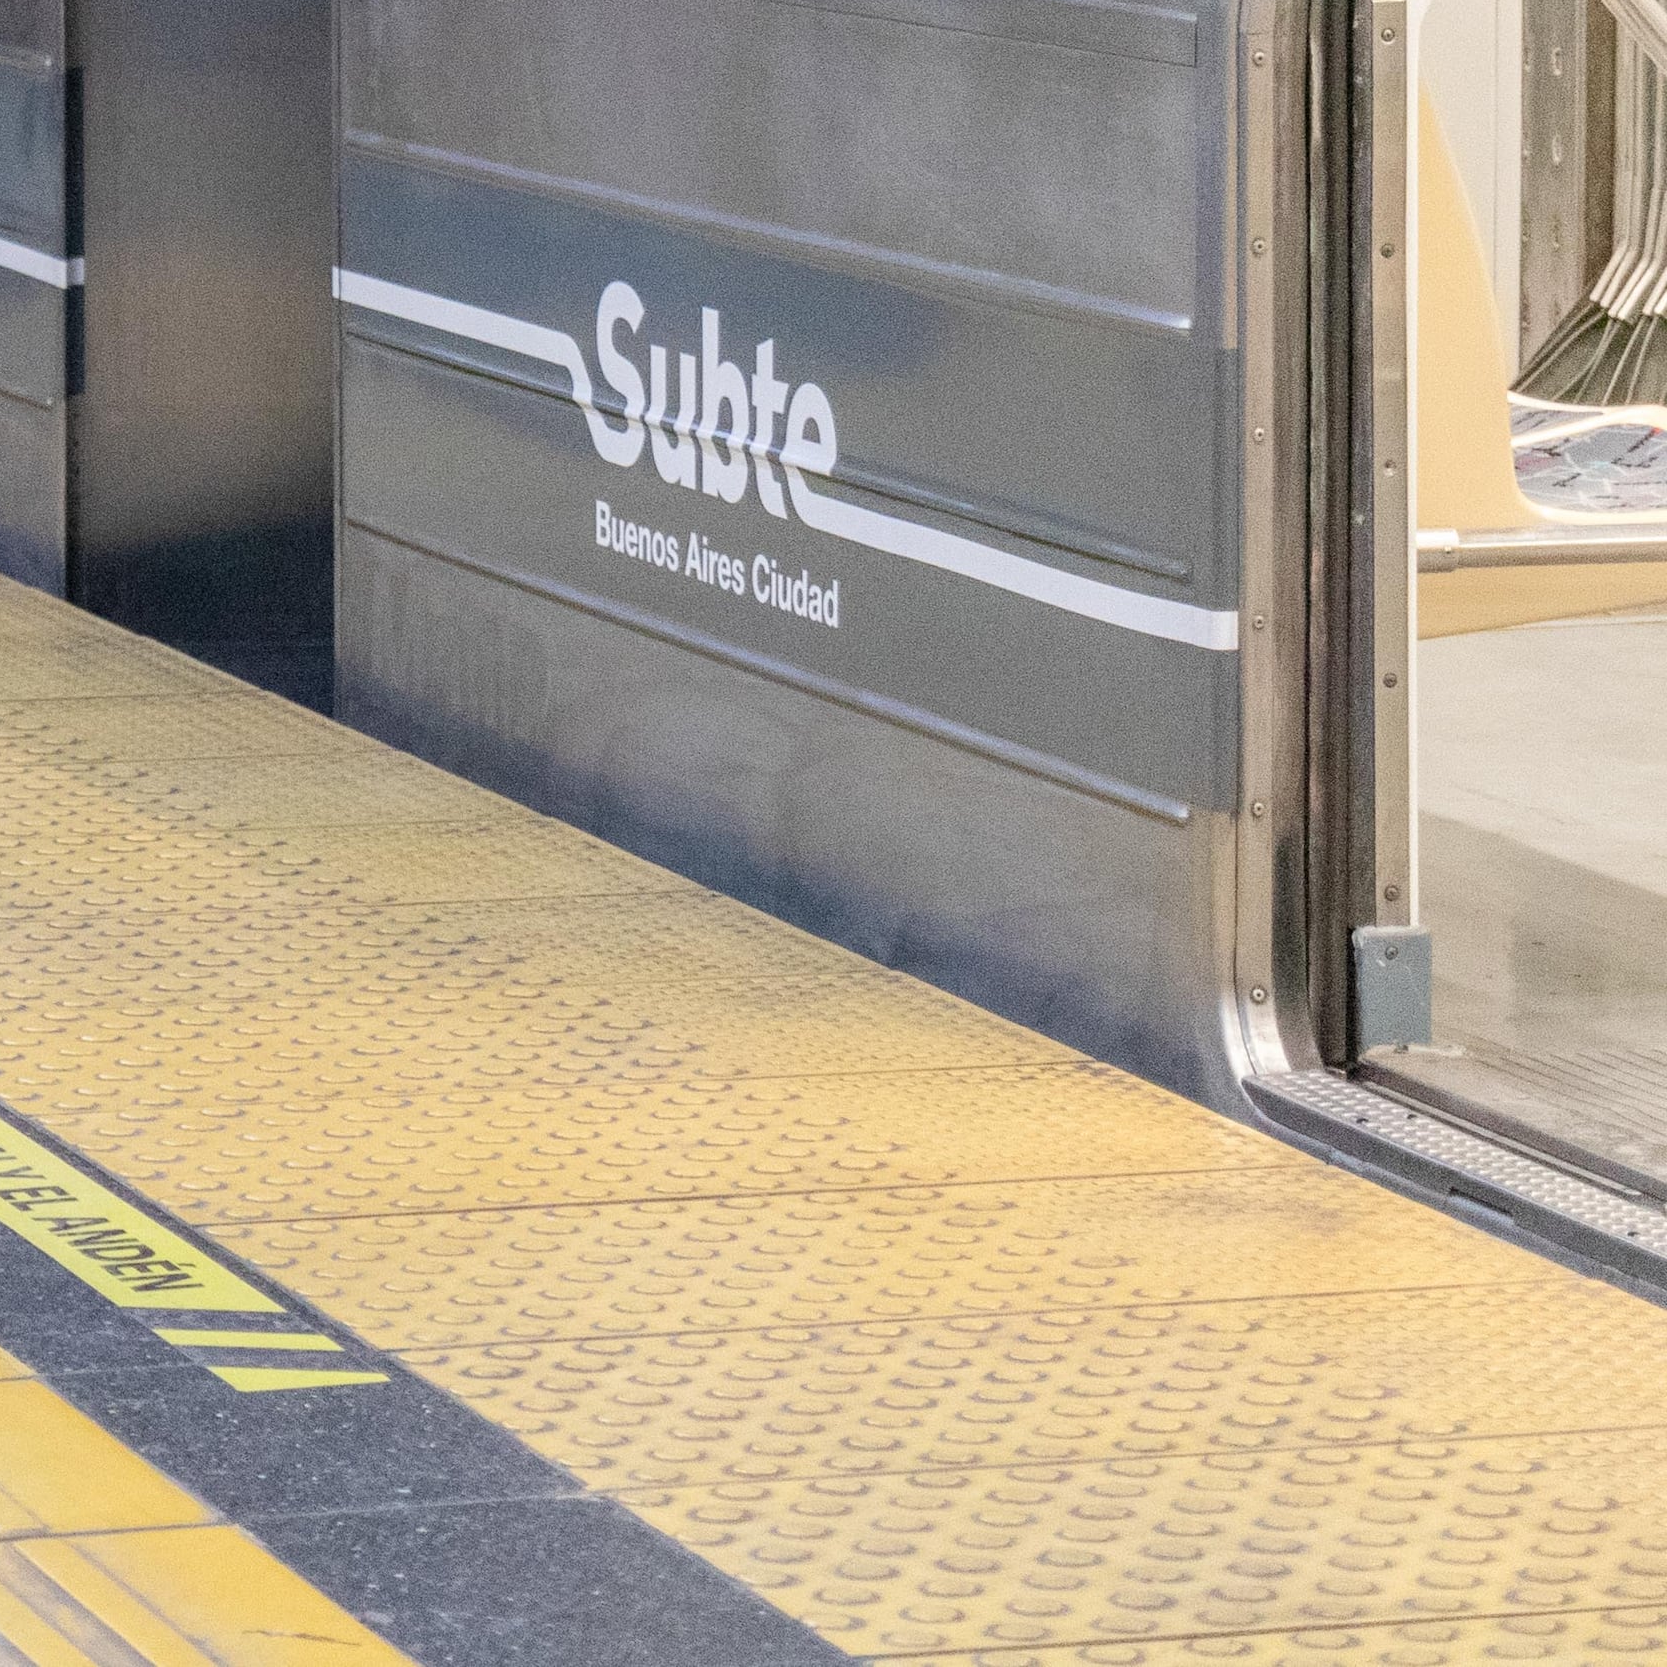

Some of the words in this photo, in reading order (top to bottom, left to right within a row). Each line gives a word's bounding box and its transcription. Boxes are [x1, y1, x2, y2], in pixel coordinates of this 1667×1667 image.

[587, 280, 838, 528] Subte
[595, 499, 679, 572] Buenos
[684, 532, 745, 596] Aires
[752, 554, 839, 629] Ciudad
[33, 1214, 205, 1294] ANDÉN
